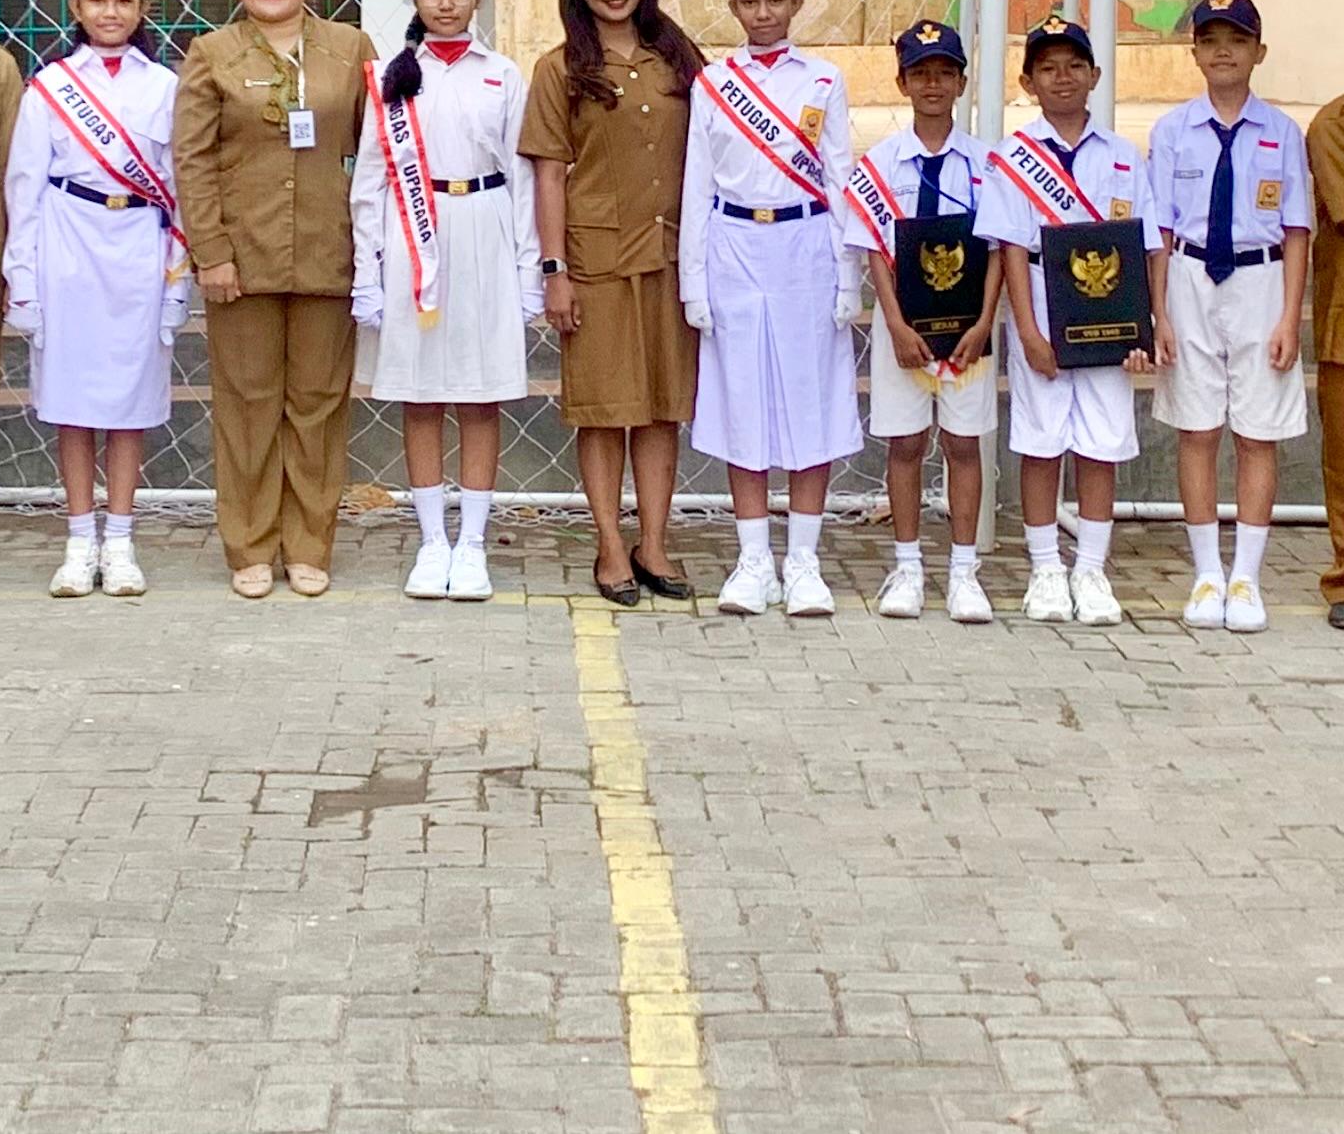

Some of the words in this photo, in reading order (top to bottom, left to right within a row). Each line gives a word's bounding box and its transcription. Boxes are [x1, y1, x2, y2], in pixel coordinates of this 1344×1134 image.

[58, 83, 116, 145] PETUGAS
[720, 79, 780, 142] PETUGAS
[403, 163, 433, 243] UPACARA
[1010, 145, 1076, 211] PETUGAS
